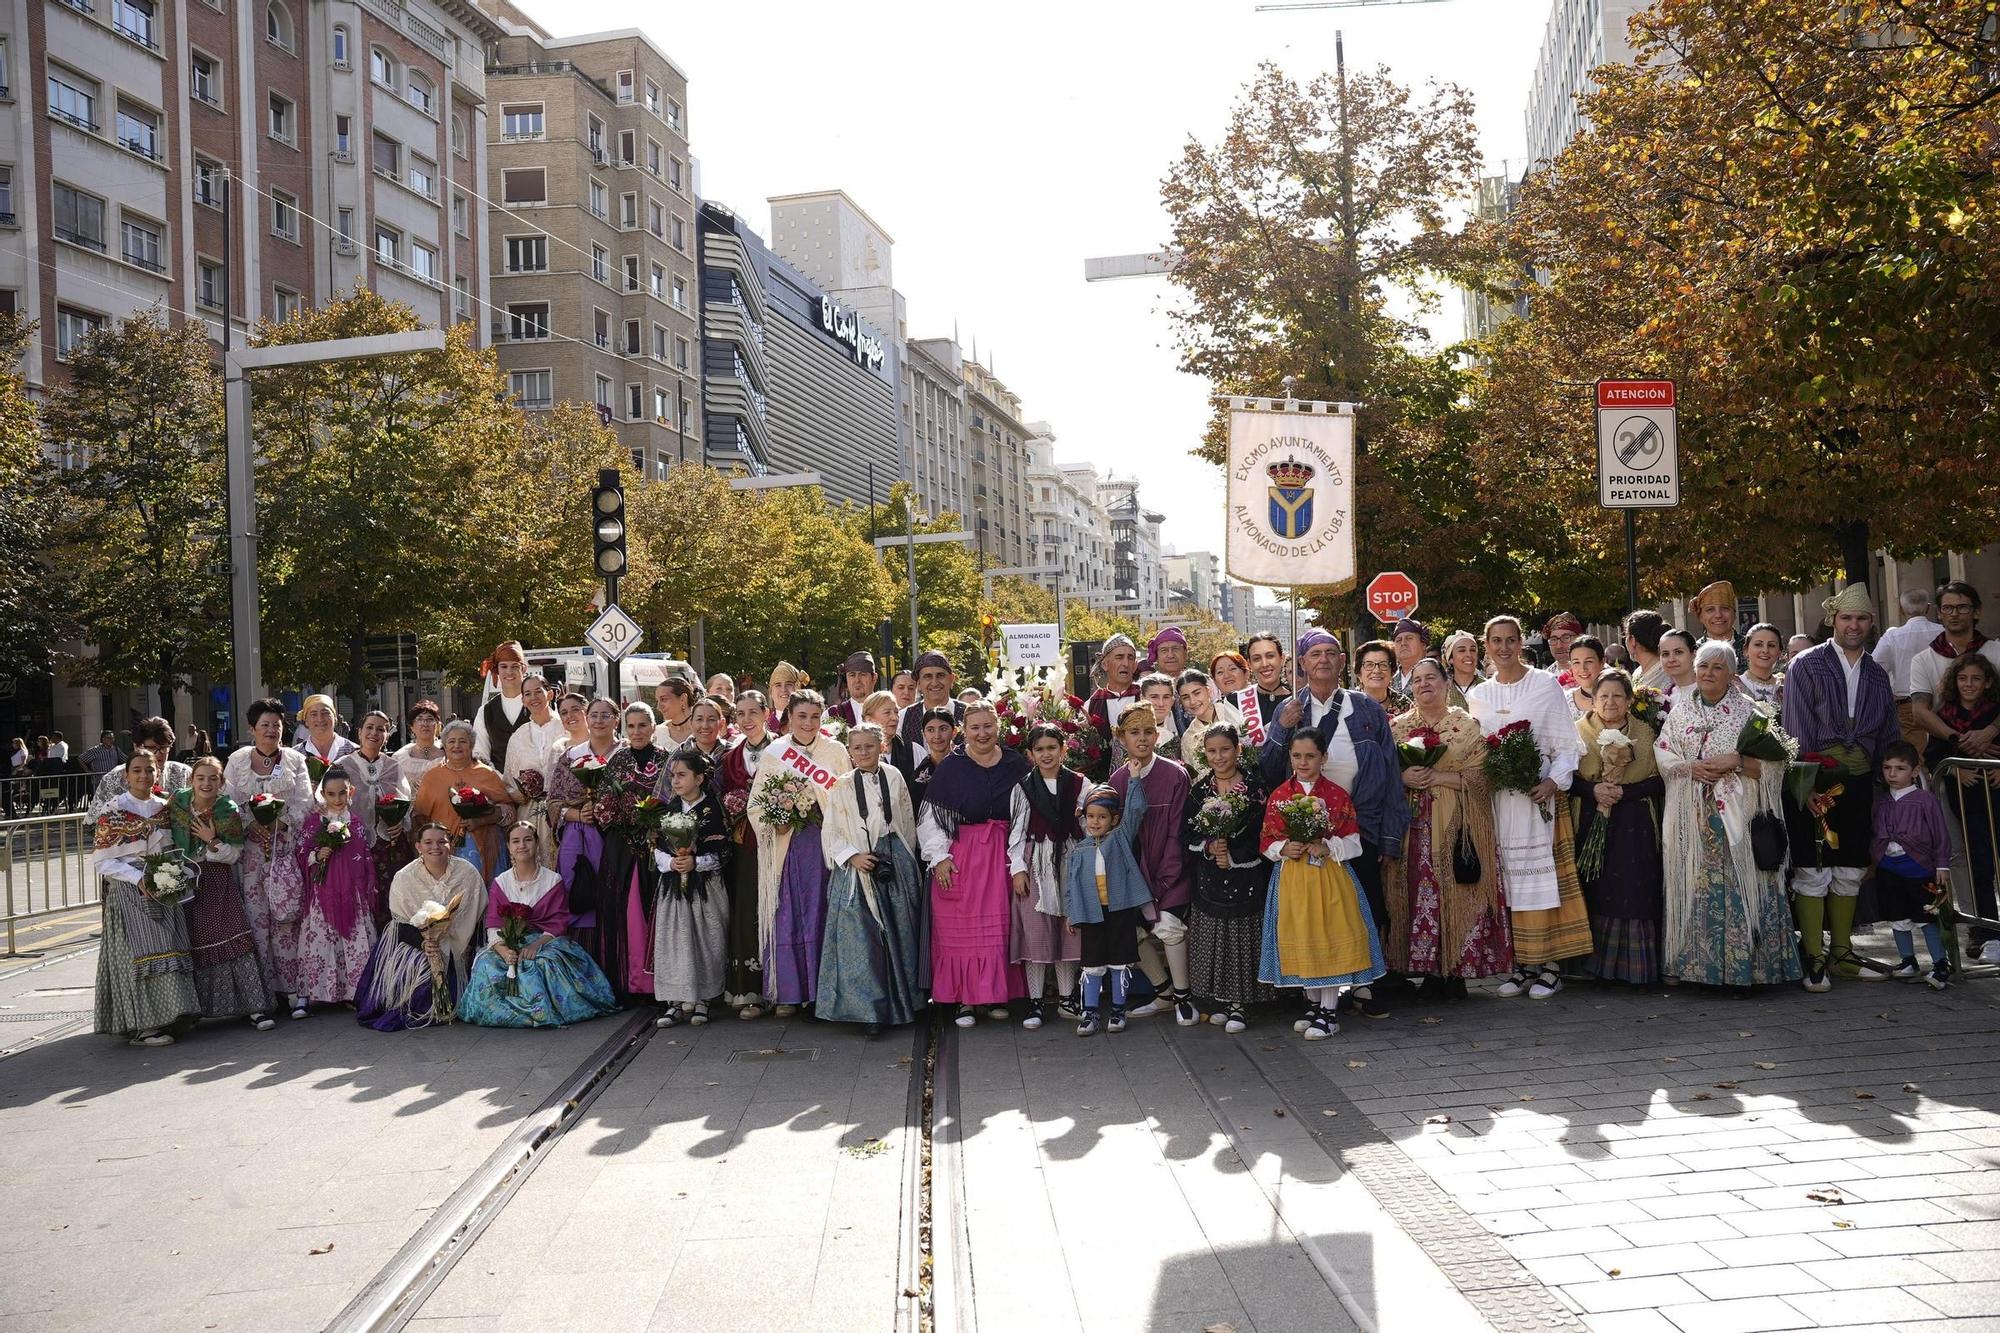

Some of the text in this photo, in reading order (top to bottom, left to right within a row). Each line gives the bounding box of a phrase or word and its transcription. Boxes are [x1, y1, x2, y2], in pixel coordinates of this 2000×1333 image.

[1606, 388, 1666, 399] ATENCIÓN
[1619, 431, 1658, 455] 20
[1236, 436, 1343, 486] EXCMO AYUNTAMIENTO
[1609, 475, 1671, 484] PRIORIDAD
[1610, 490, 1670, 499] PEATONAL
[1235, 504, 1346, 557] ALMONACID DE LA CUBA
[1373, 591, 1412, 604] STOP
[601, 623, 627, 642] 30
[1241, 688, 1265, 746] PRIOR
